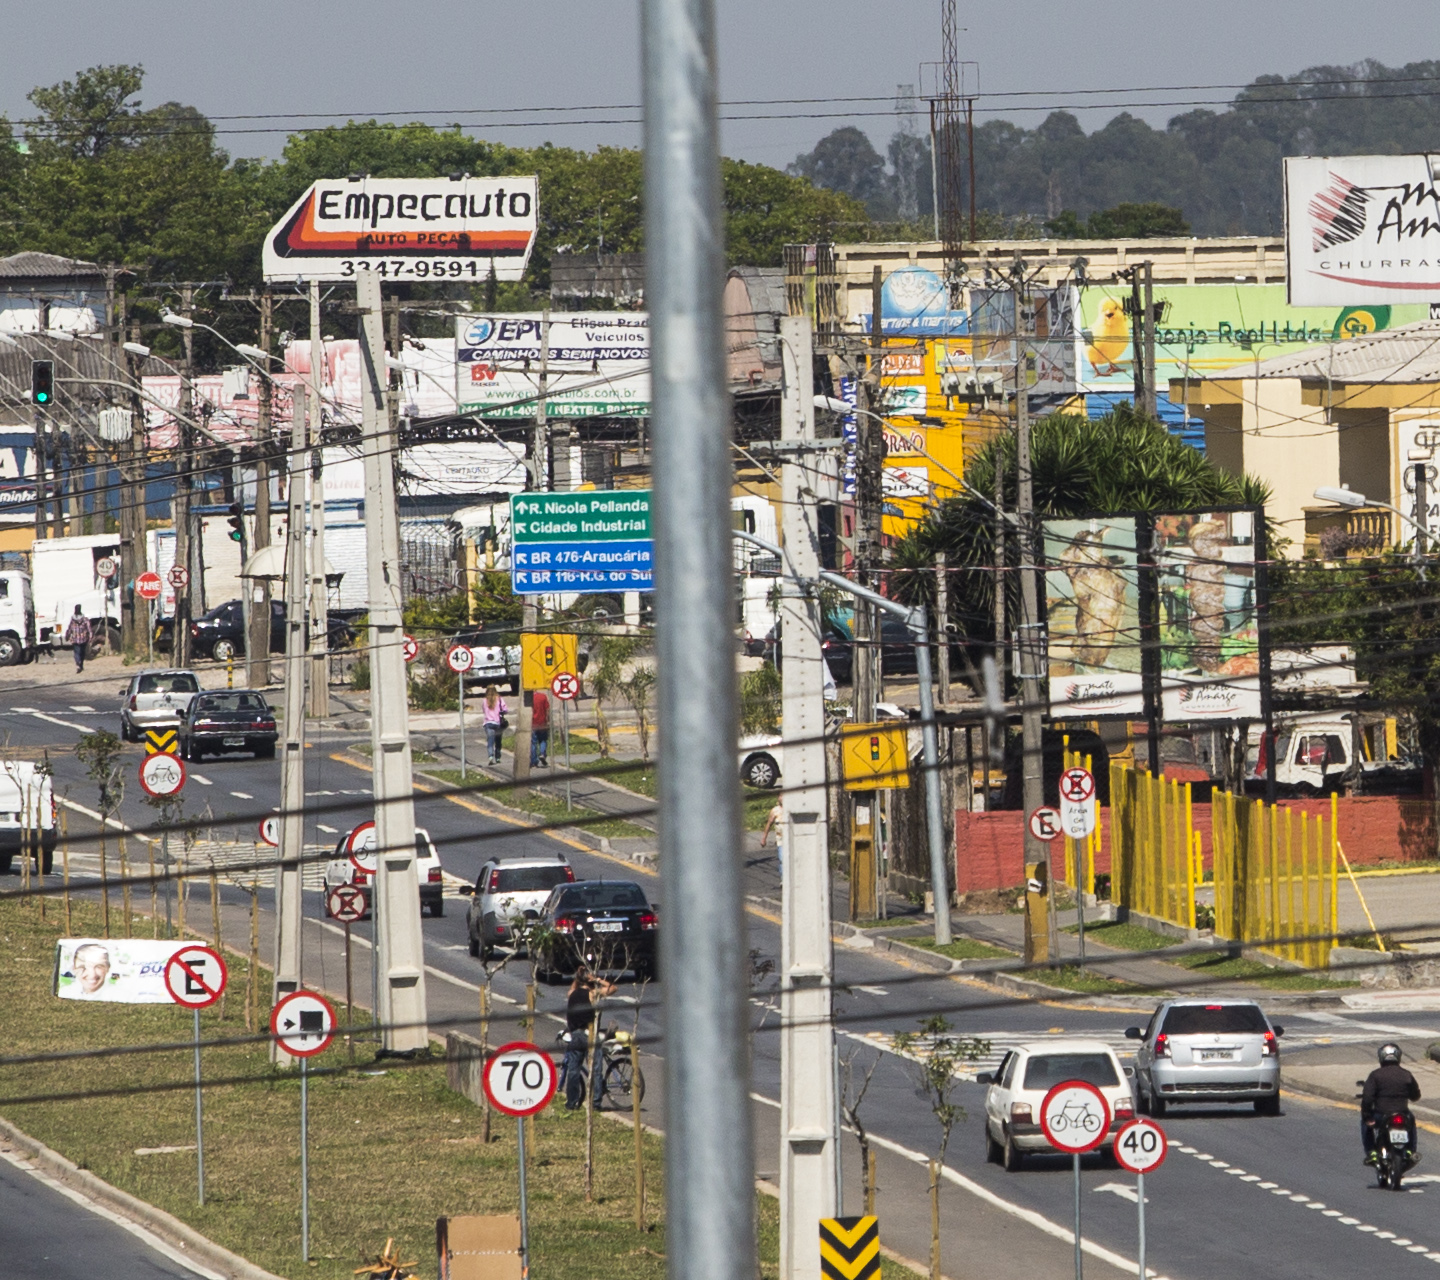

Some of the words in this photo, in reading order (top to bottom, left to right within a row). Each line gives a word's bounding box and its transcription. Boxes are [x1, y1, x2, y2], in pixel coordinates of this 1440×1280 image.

[365, 233, 406, 245] AUTO
[529, 502, 543, 514] R.
[544, 500, 588, 514] Nicola
[590, 499, 649, 513] Pellanda
[530, 521, 578, 534] Cidade
[581, 519, 647, 532] Industrial
[531, 552, 551, 565] BR
[531, 572, 552, 584] BR
[136, 581, 161, 591] PARE
[451, 651, 469, 663] 40
[501, 1059, 544, 1092] 70
[1123, 1130, 1157, 1154] 40
